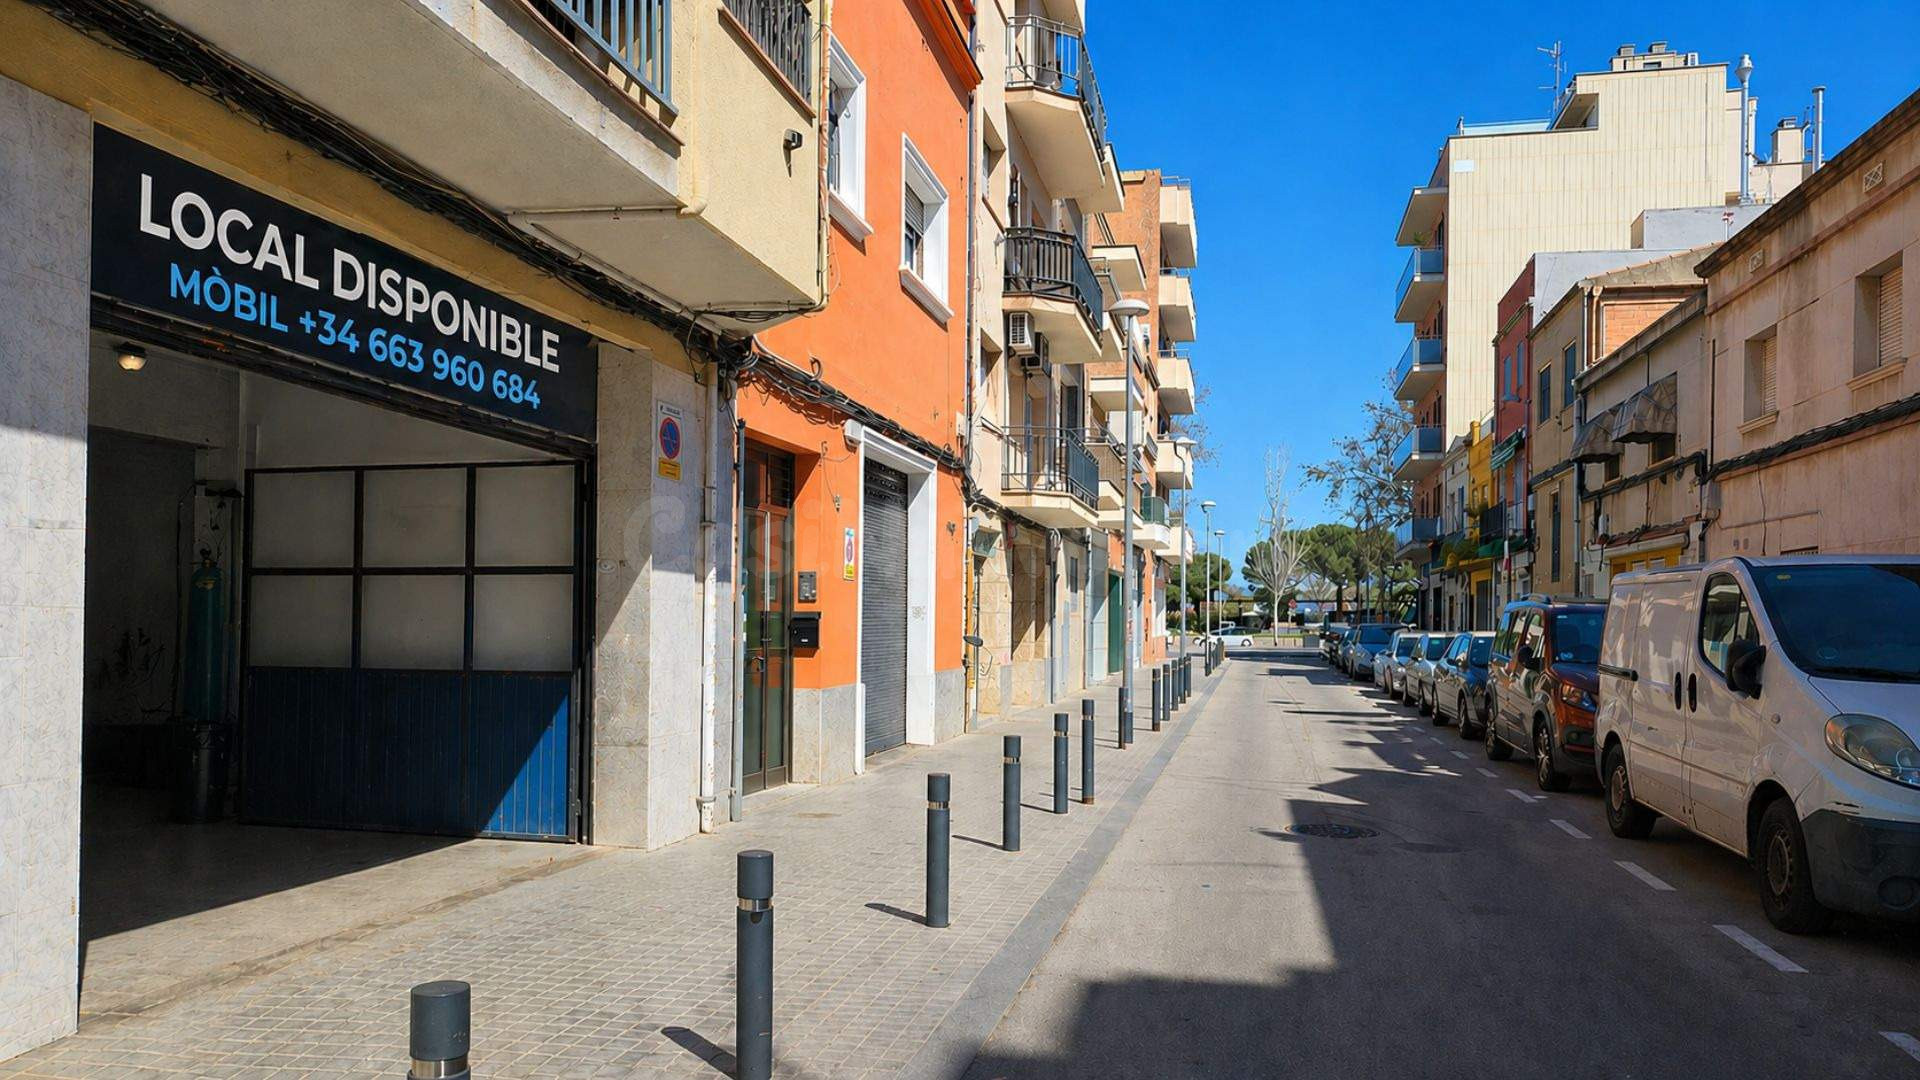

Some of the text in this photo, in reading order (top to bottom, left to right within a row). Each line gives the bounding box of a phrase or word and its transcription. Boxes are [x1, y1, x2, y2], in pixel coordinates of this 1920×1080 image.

[140, 173, 560, 373] LOCAL DISPONIBLE
[170, 262, 541, 410] MÒBIL +34 663 960 684
